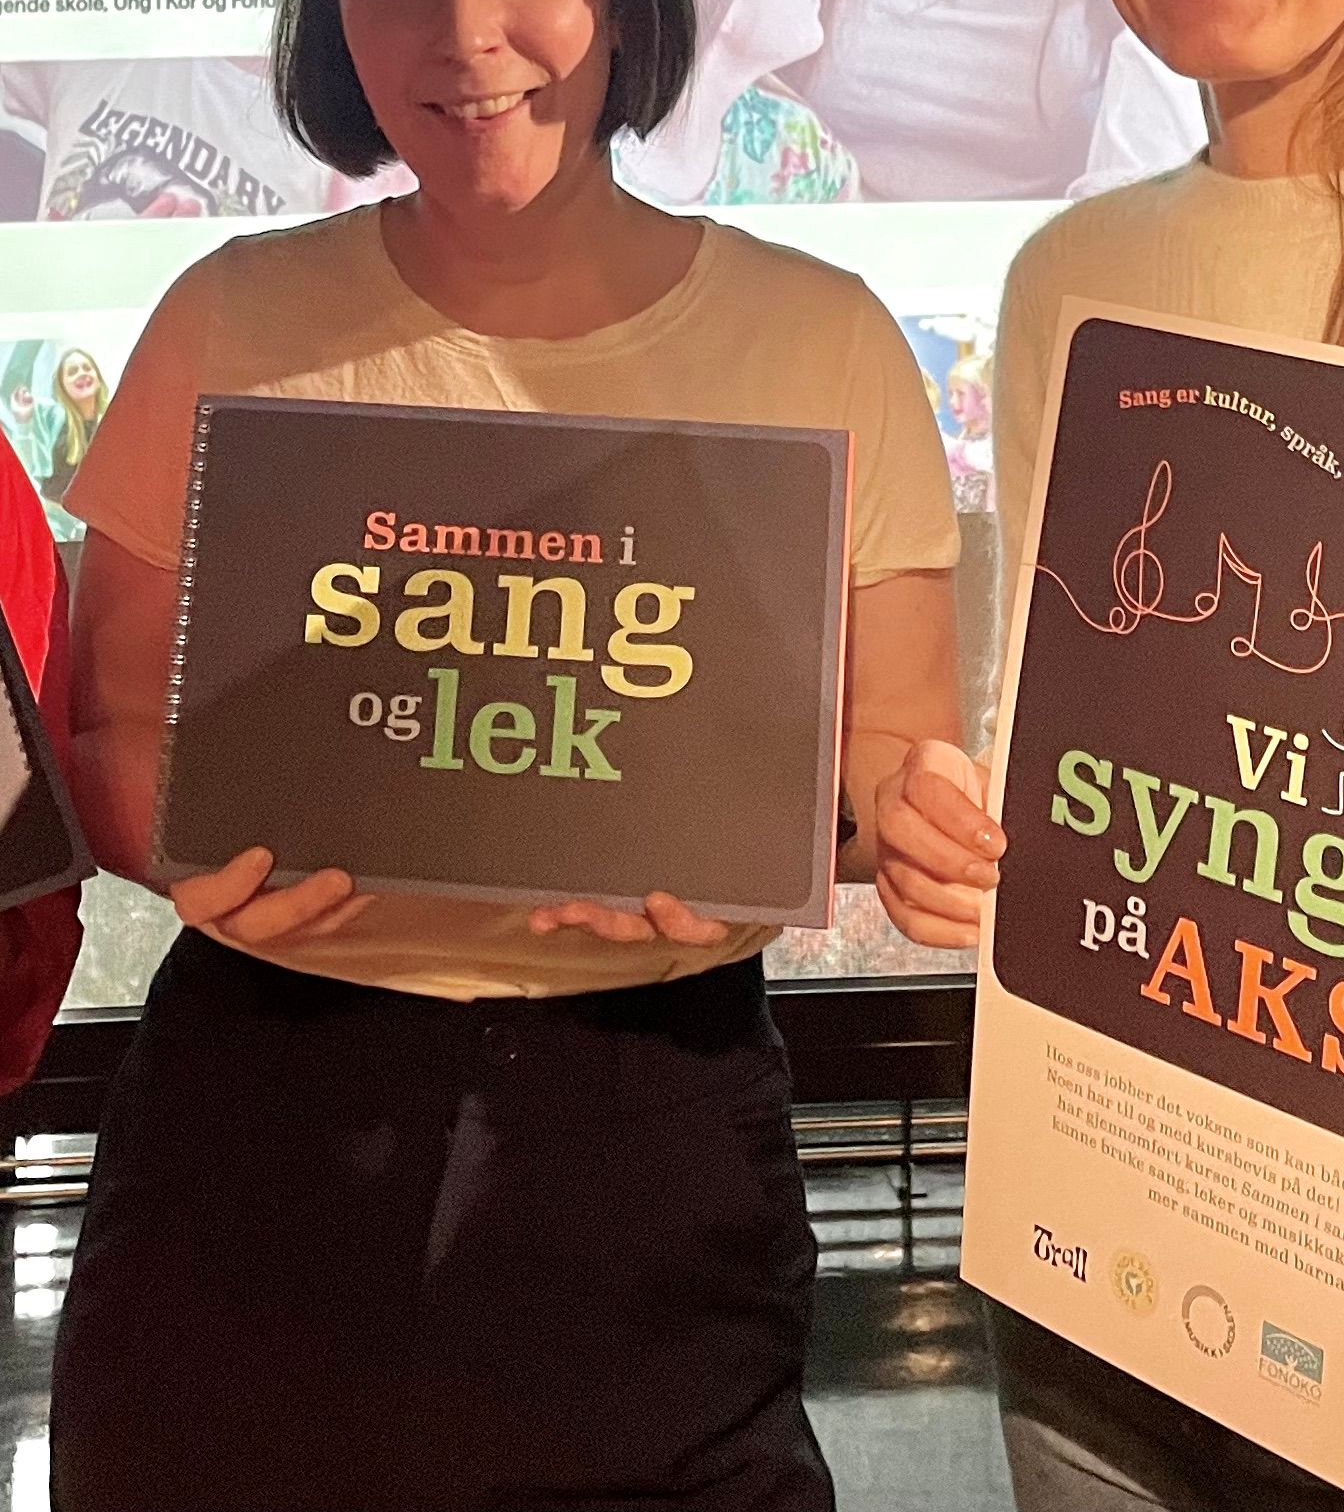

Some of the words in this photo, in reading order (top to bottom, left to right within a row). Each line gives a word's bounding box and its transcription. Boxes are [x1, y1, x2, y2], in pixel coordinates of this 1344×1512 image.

[77, 98, 287, 216] LEGENDARY
[1119, 388, 1171, 409] Sang
[1176, 388, 1200, 404] er
[1202, 384, 1276, 432] kultur,
[1279, 425, 1342, 480] språk,
[363, 510, 604, 565] Sammen
[619, 526, 637, 567] i
[303, 561, 697, 699] sang
[348, 690, 423, 742] og
[419, 667, 623, 782] lek
[1226, 713, 1311, 807] Vi
[1079, 895, 1150, 960] på
[1045, 1043, 1073, 1067] Hos
[1076, 1061, 1101, 1081] oss
[1104, 1069, 1155, 1105] jobber
[1156, 1095, 1183, 1117] det
[1187, 1109, 1243, 1145] voksne
[1246, 1136, 1280, 1162] som
[1284, 1148, 1316, 1177] kan
[1046, 1067, 1084, 1098] Noen
[1087, 1085, 1114, 1110] har
[1117, 1099, 1135, 1121] til
[1137, 1111, 1156, 1133] og
[1159, 1121, 1193, 1146] med
[1196, 1134, 1277, 1183] kursbevis
[1280, 1174, 1302, 1197] på
[1057, 1093, 1084, 1119] har
[1086, 1110, 1182, 1166] gjennomført
[1185, 1153, 1238, 1191] kurset
[1241, 1180, 1310, 1226] Sammen
[1313, 1212, 1320, 1230] i
[1052, 1114, 1098, 1149] kunne
[1101, 1137, 1146, 1172] bruke
[1193, 1181, 1236, 1213] leker
[1238, 1204, 1258, 1228] og
[1147, 1188, 1179, 1212] mer
[1182, 1203, 1251, 1247] sammen
[1254, 1238, 1289, 1265] med
